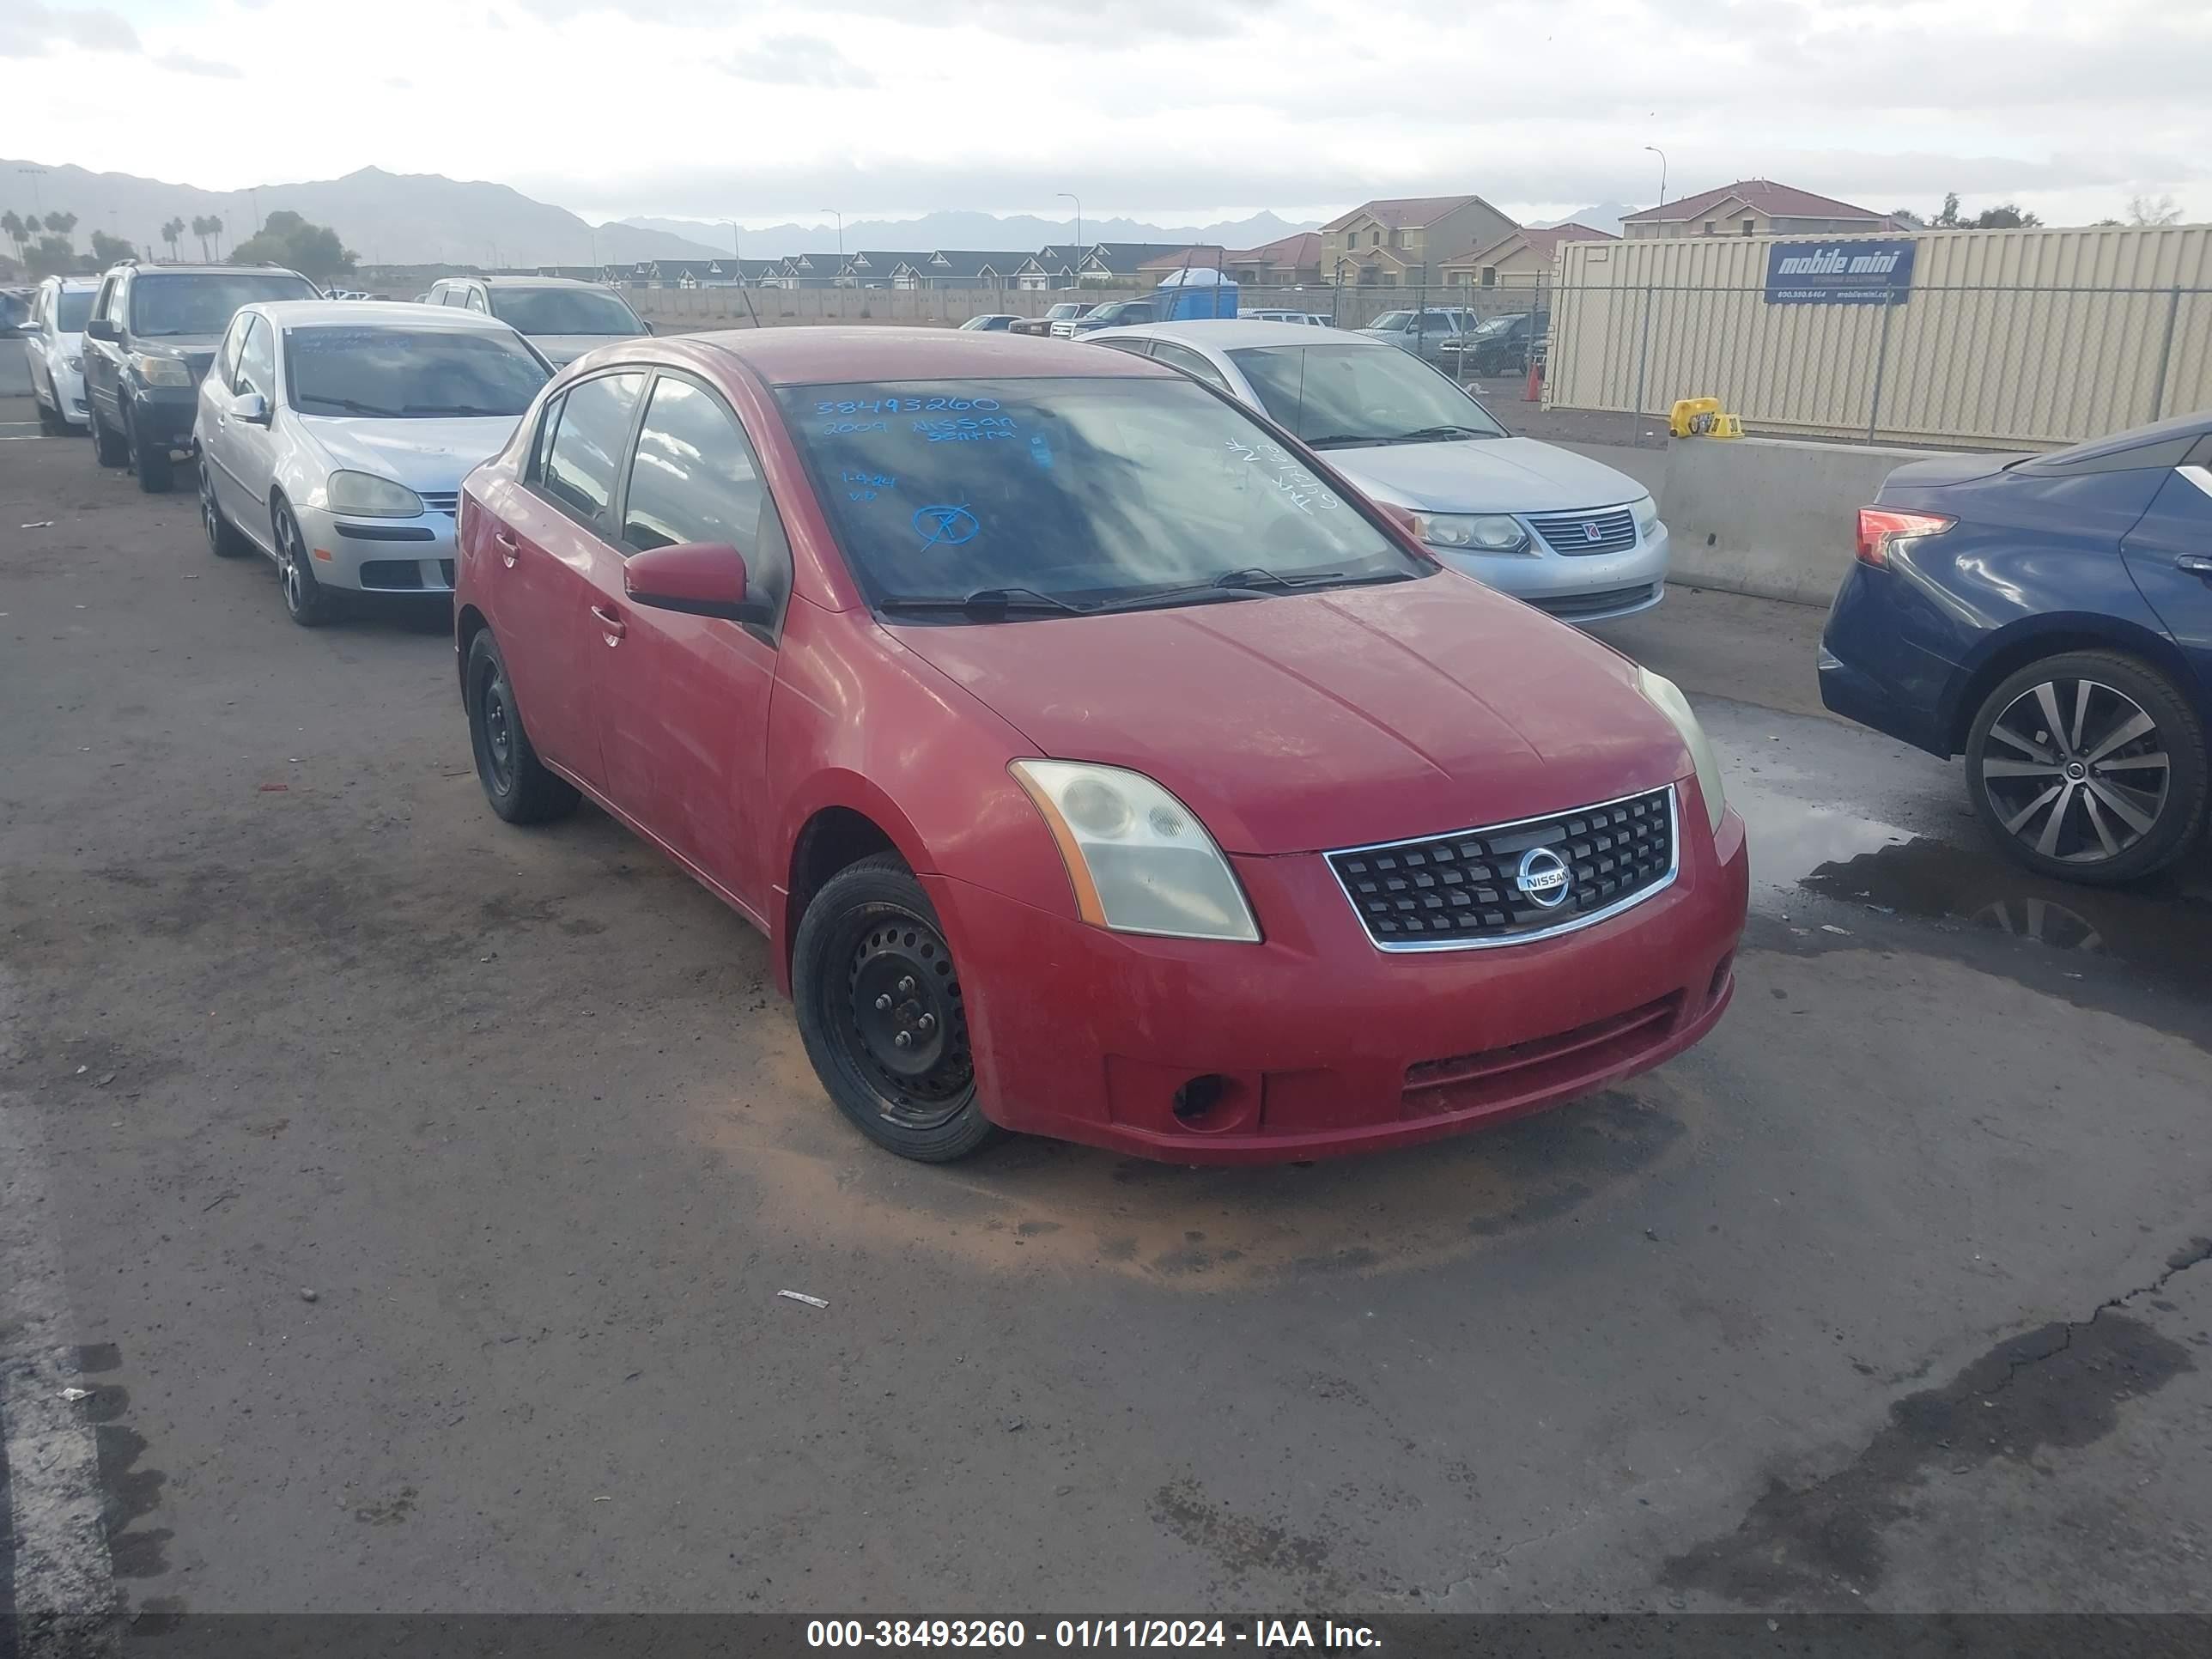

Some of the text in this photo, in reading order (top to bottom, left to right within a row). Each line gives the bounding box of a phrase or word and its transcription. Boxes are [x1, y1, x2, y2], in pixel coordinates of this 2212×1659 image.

[1778, 248, 1900, 275] mobile mini
[815, 397, 1000, 415] 38493260
[823, 421, 888, 435] 2009
[1526, 871, 1569, 888] NISSAN
